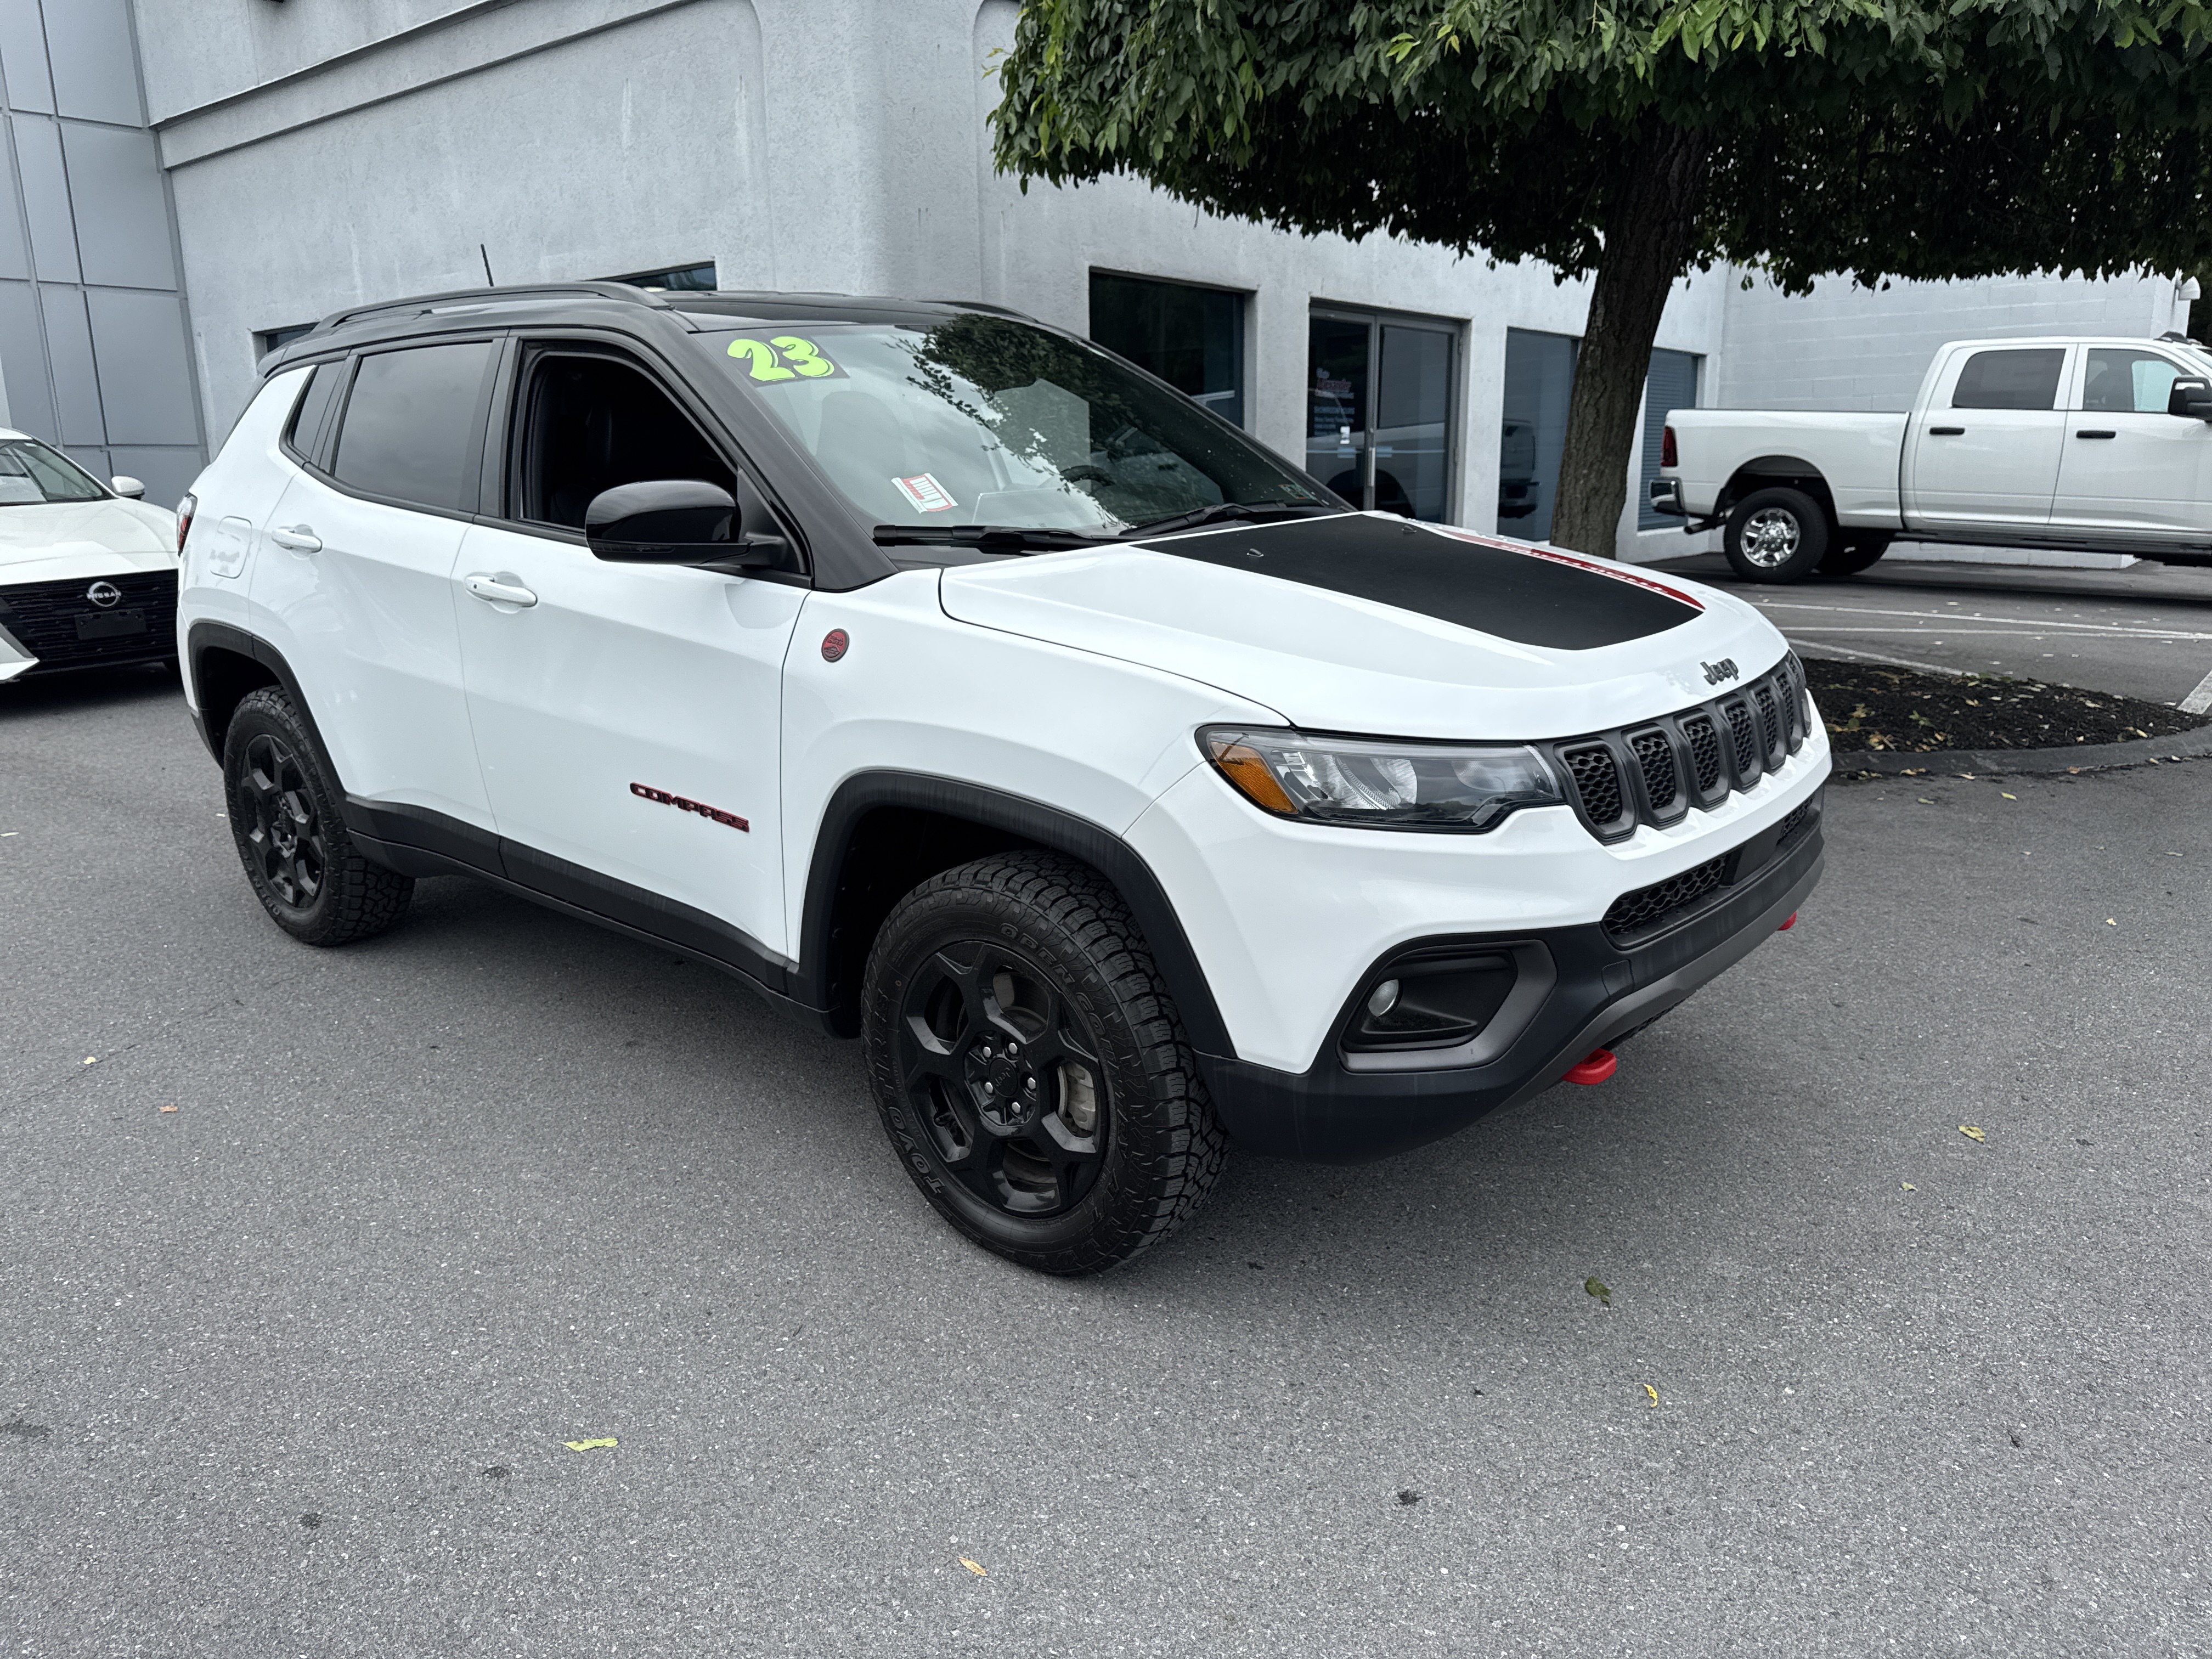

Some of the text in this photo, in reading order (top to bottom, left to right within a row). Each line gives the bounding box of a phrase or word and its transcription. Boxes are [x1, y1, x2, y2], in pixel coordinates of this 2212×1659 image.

[727, 336, 834, 381] 23
[1700, 658, 1739, 686] Jeep
[630, 782, 749, 832] COMPASS
[1000, 923, 1074, 985] OPEN
[995, 1068, 1011, 1087] Jeep
[888, 1106, 945, 1195] TOYO
